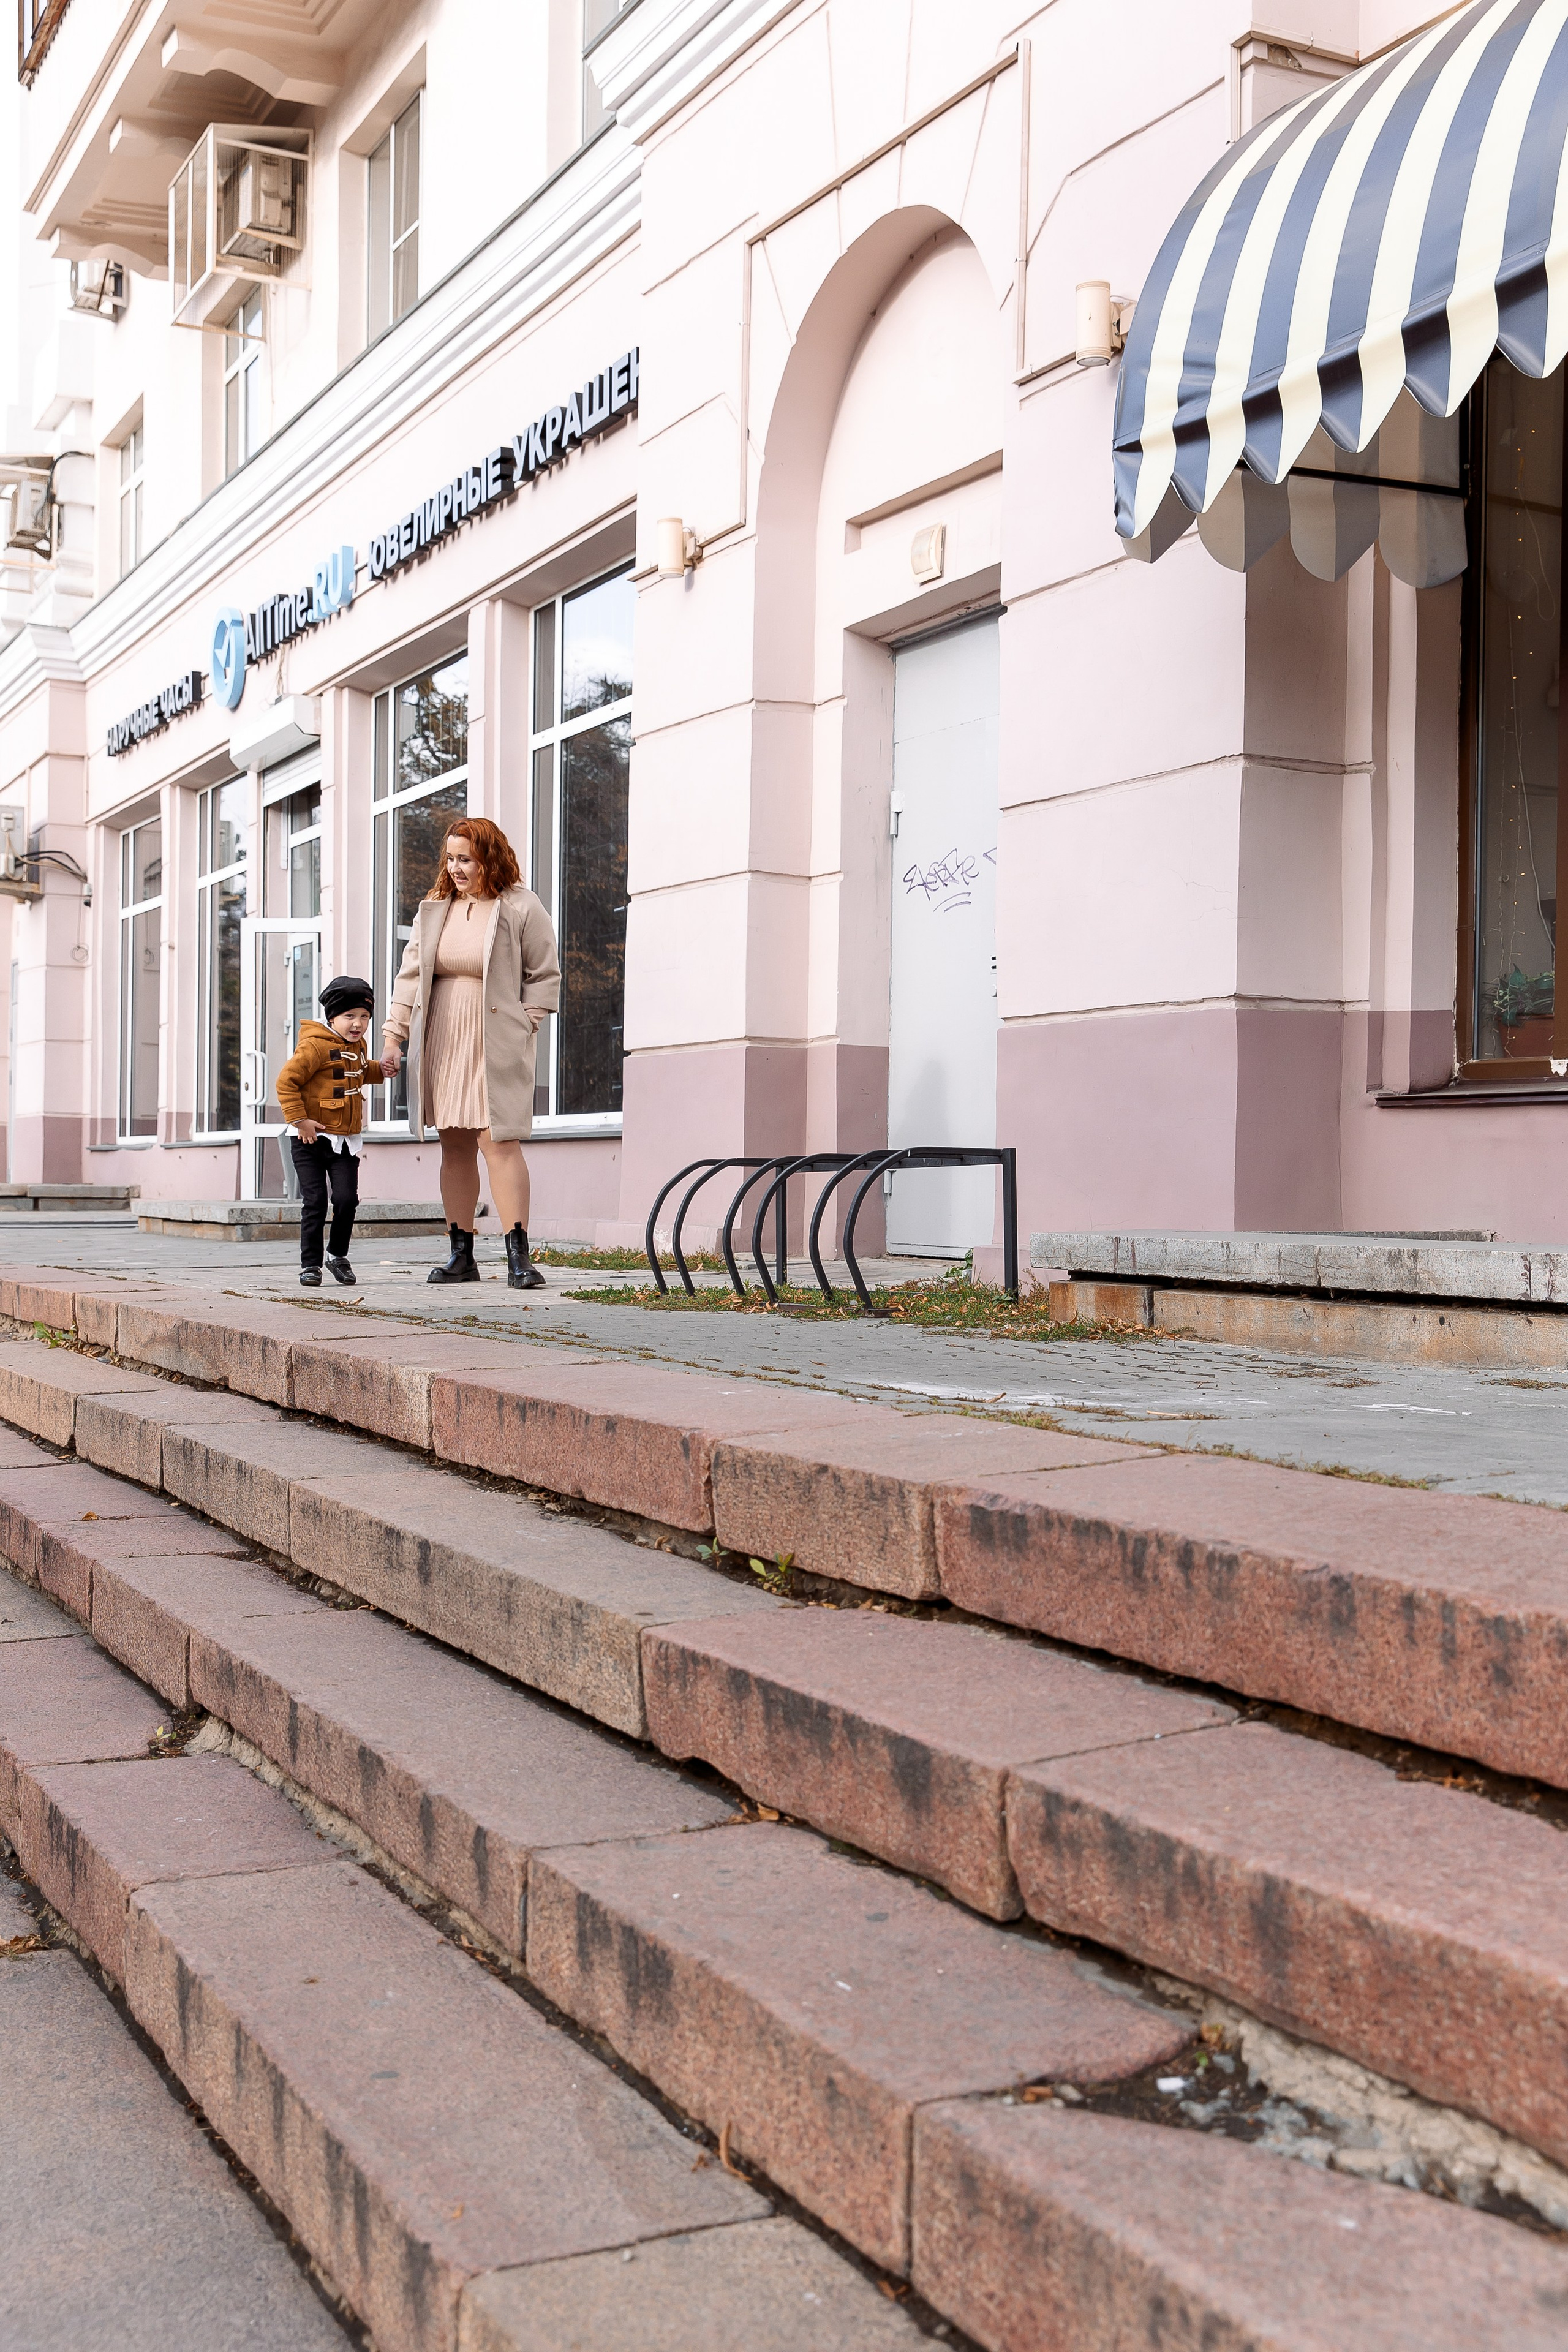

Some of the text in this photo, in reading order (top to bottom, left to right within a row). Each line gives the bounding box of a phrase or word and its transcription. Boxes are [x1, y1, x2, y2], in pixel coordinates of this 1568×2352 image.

[368, 447, 505, 581] ЮВЕЛИРНЫЕ
[107, 671, 196, 756] НАРУЧНЫЕ ЧАСЫ
